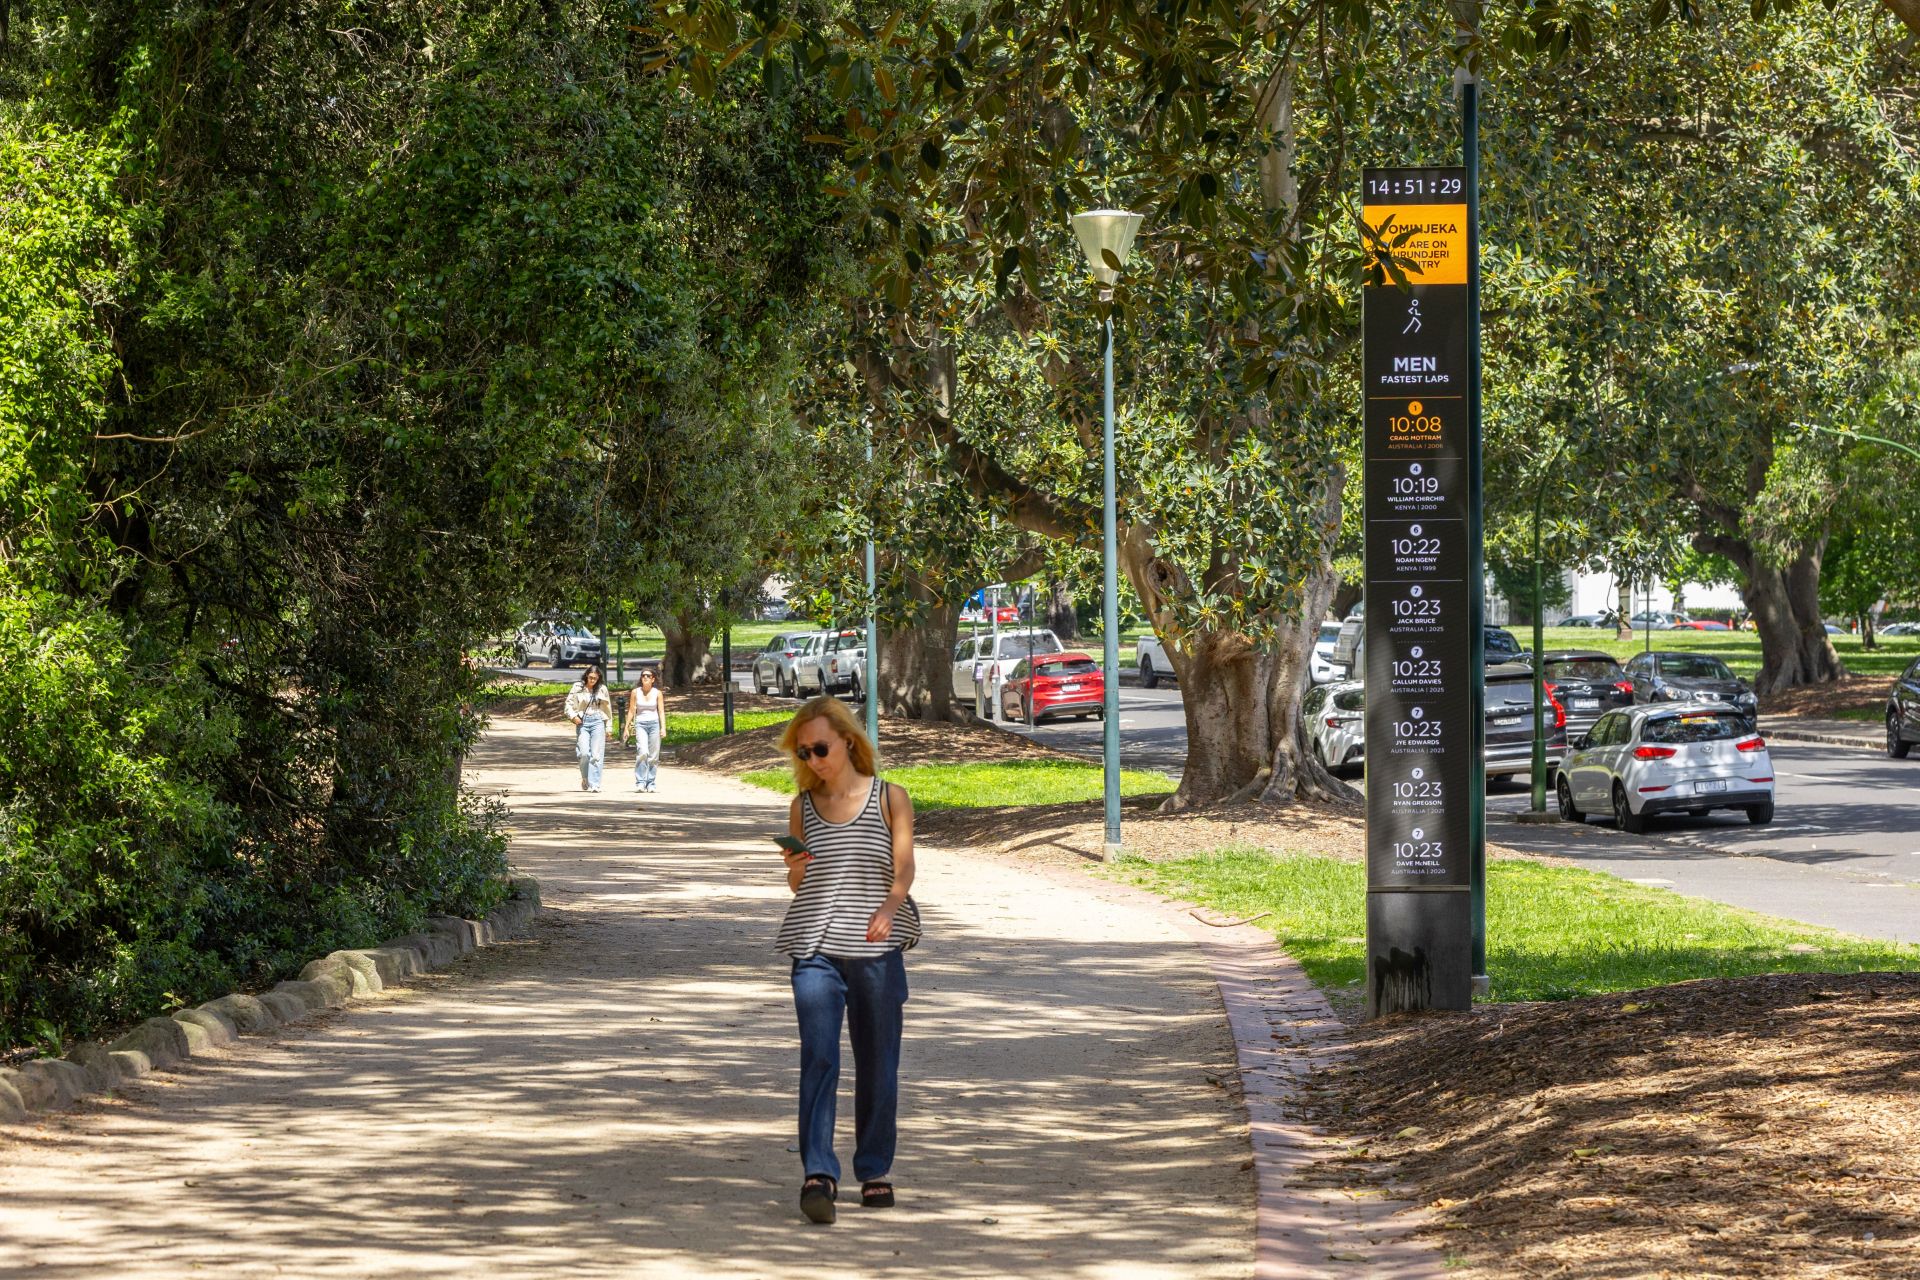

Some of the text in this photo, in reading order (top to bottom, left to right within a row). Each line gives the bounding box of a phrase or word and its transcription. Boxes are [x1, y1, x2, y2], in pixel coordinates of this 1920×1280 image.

[1394, 357, 1436, 372] MEN
[1425, 375, 1449, 383] LAPS
[1389, 416, 1441, 432] 10:08
[1392, 477, 1438, 493] 10:19
[1392, 539, 1440, 555] 10:22
[1392, 600, 1441, 616] 10:23
[1392, 660, 1441, 676] 10:23
[1393, 721, 1442, 737] 10:23
[1393, 782, 1442, 797] 10:23
[1393, 842, 1442, 858] 10:23
